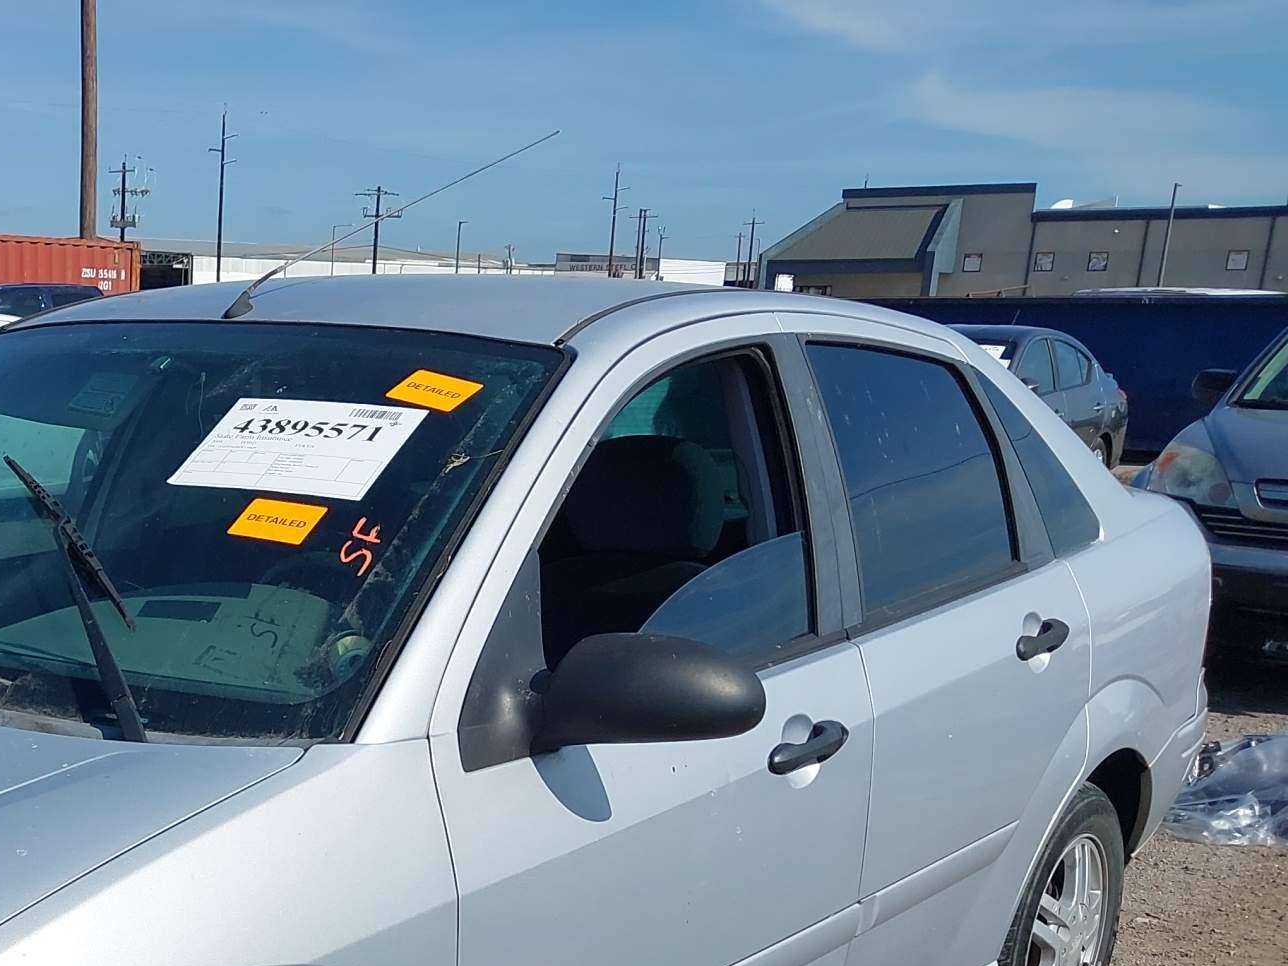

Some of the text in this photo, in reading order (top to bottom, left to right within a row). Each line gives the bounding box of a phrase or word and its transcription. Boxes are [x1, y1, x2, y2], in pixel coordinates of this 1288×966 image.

[569, 263, 603, 272] WESTERN
[406, 381, 462, 400] DETAILED
[233, 417, 384, 442] 43895571
[246, 513, 307, 530] DETAILED
